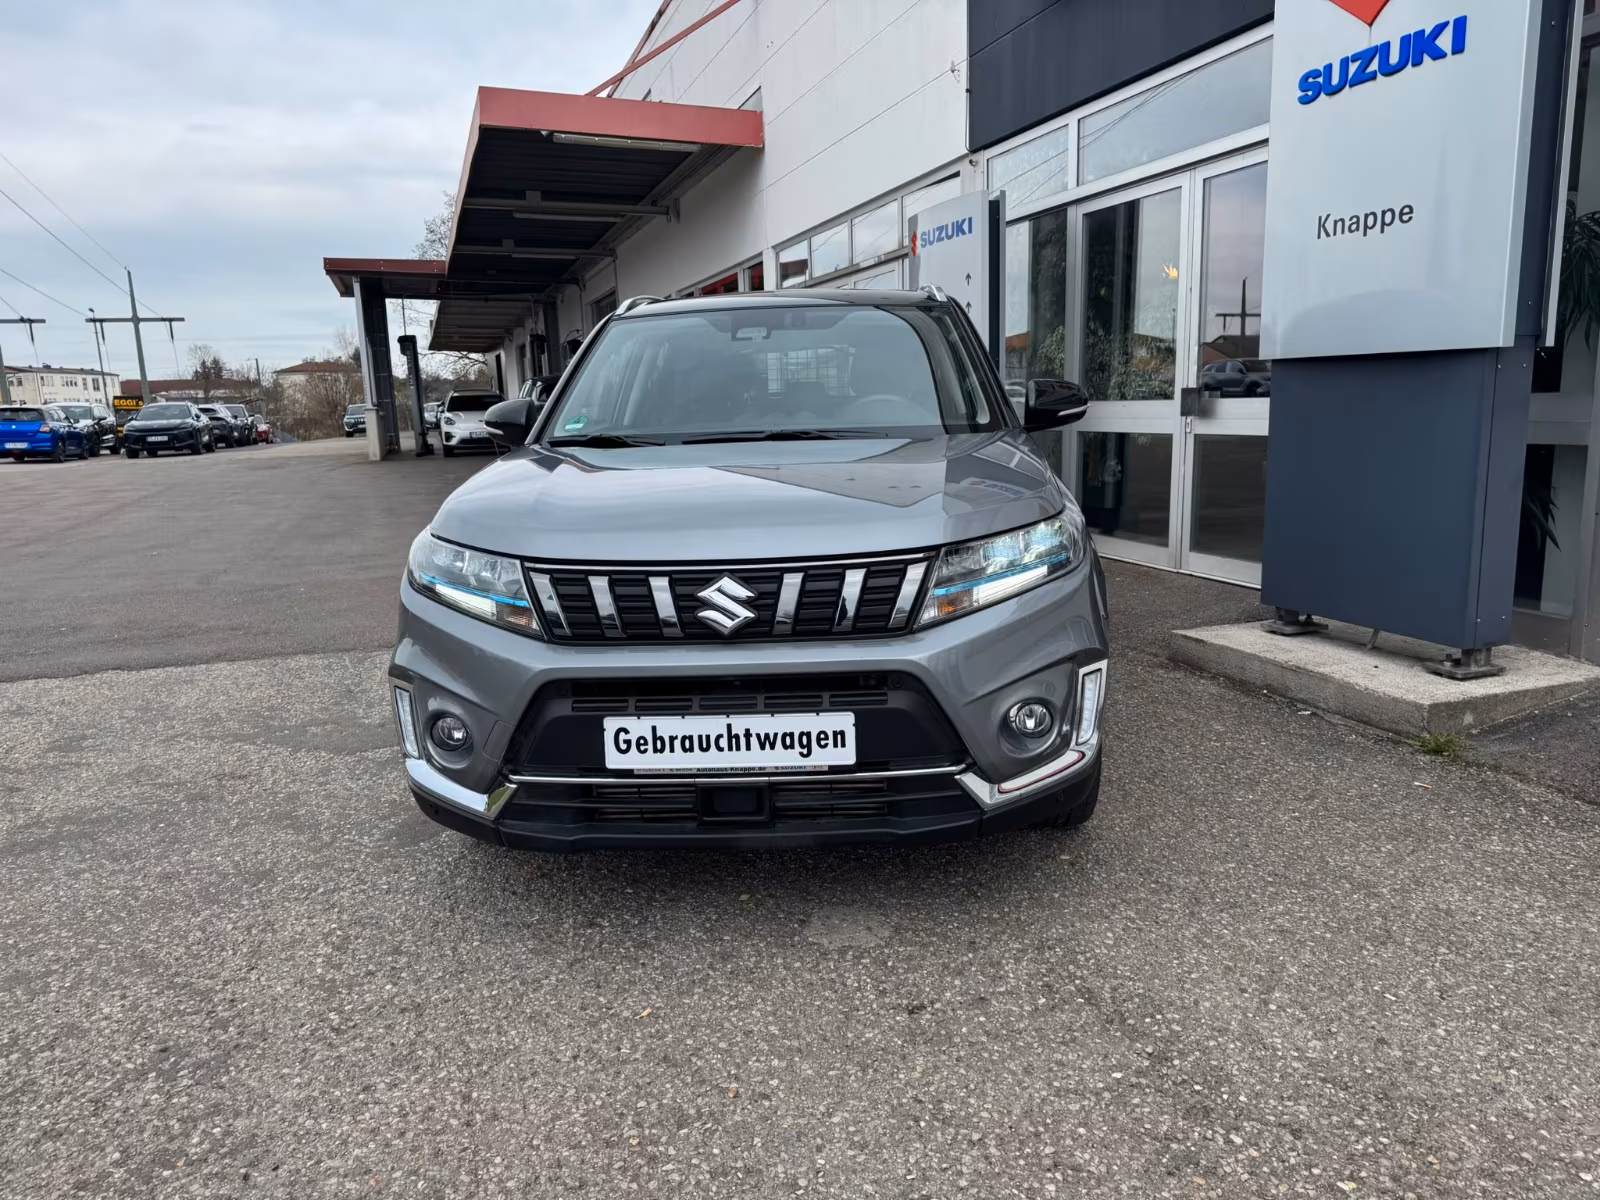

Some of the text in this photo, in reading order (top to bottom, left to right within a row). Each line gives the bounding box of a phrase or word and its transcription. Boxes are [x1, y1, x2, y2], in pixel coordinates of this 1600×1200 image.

[1297, 14, 1468, 106] SUZUKI
[920, 216, 973, 249] SUZUKI
[1316, 203, 1415, 240] Knappe
[613, 723, 847, 758] Gebrauchtwagen
